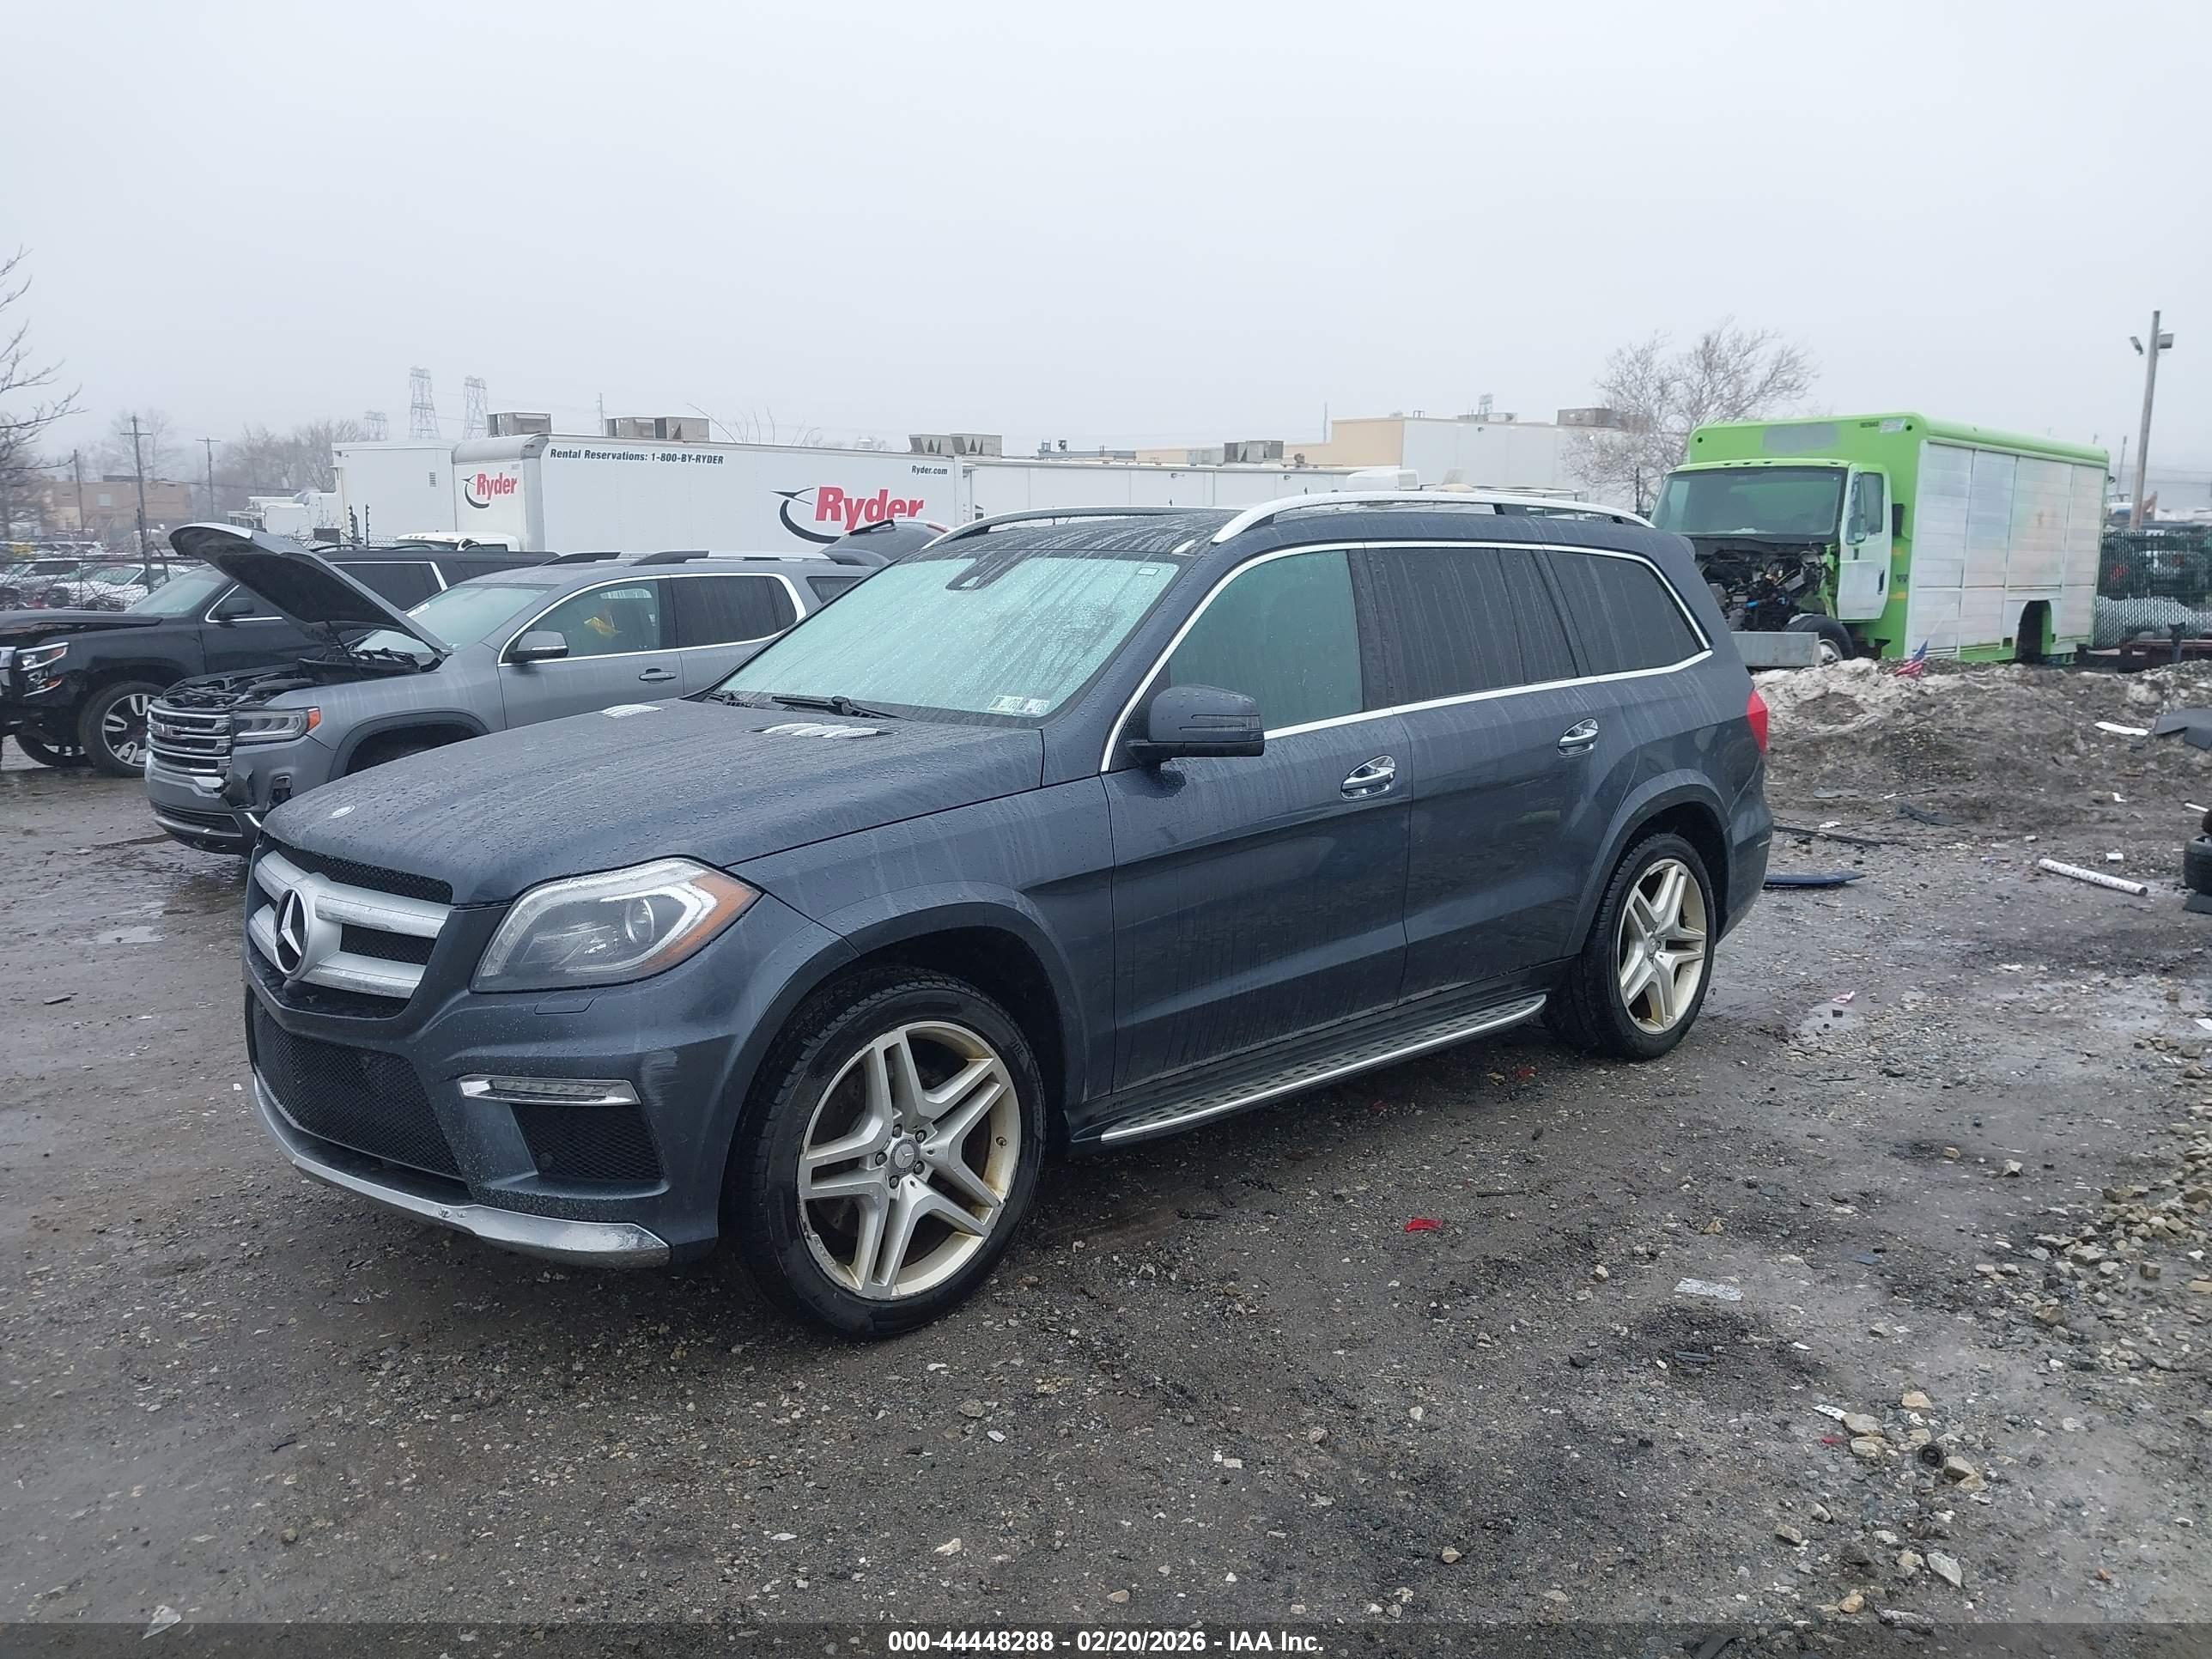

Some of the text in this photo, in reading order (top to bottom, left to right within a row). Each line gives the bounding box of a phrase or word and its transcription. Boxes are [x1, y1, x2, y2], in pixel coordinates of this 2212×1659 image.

[550, 448, 724, 465] Rental Reservations: 1-800-BY-RYDER
[911, 465, 948, 476] Ryder.com
[477, 472, 517, 501] Ryder
[815, 486, 925, 531] Ryder
